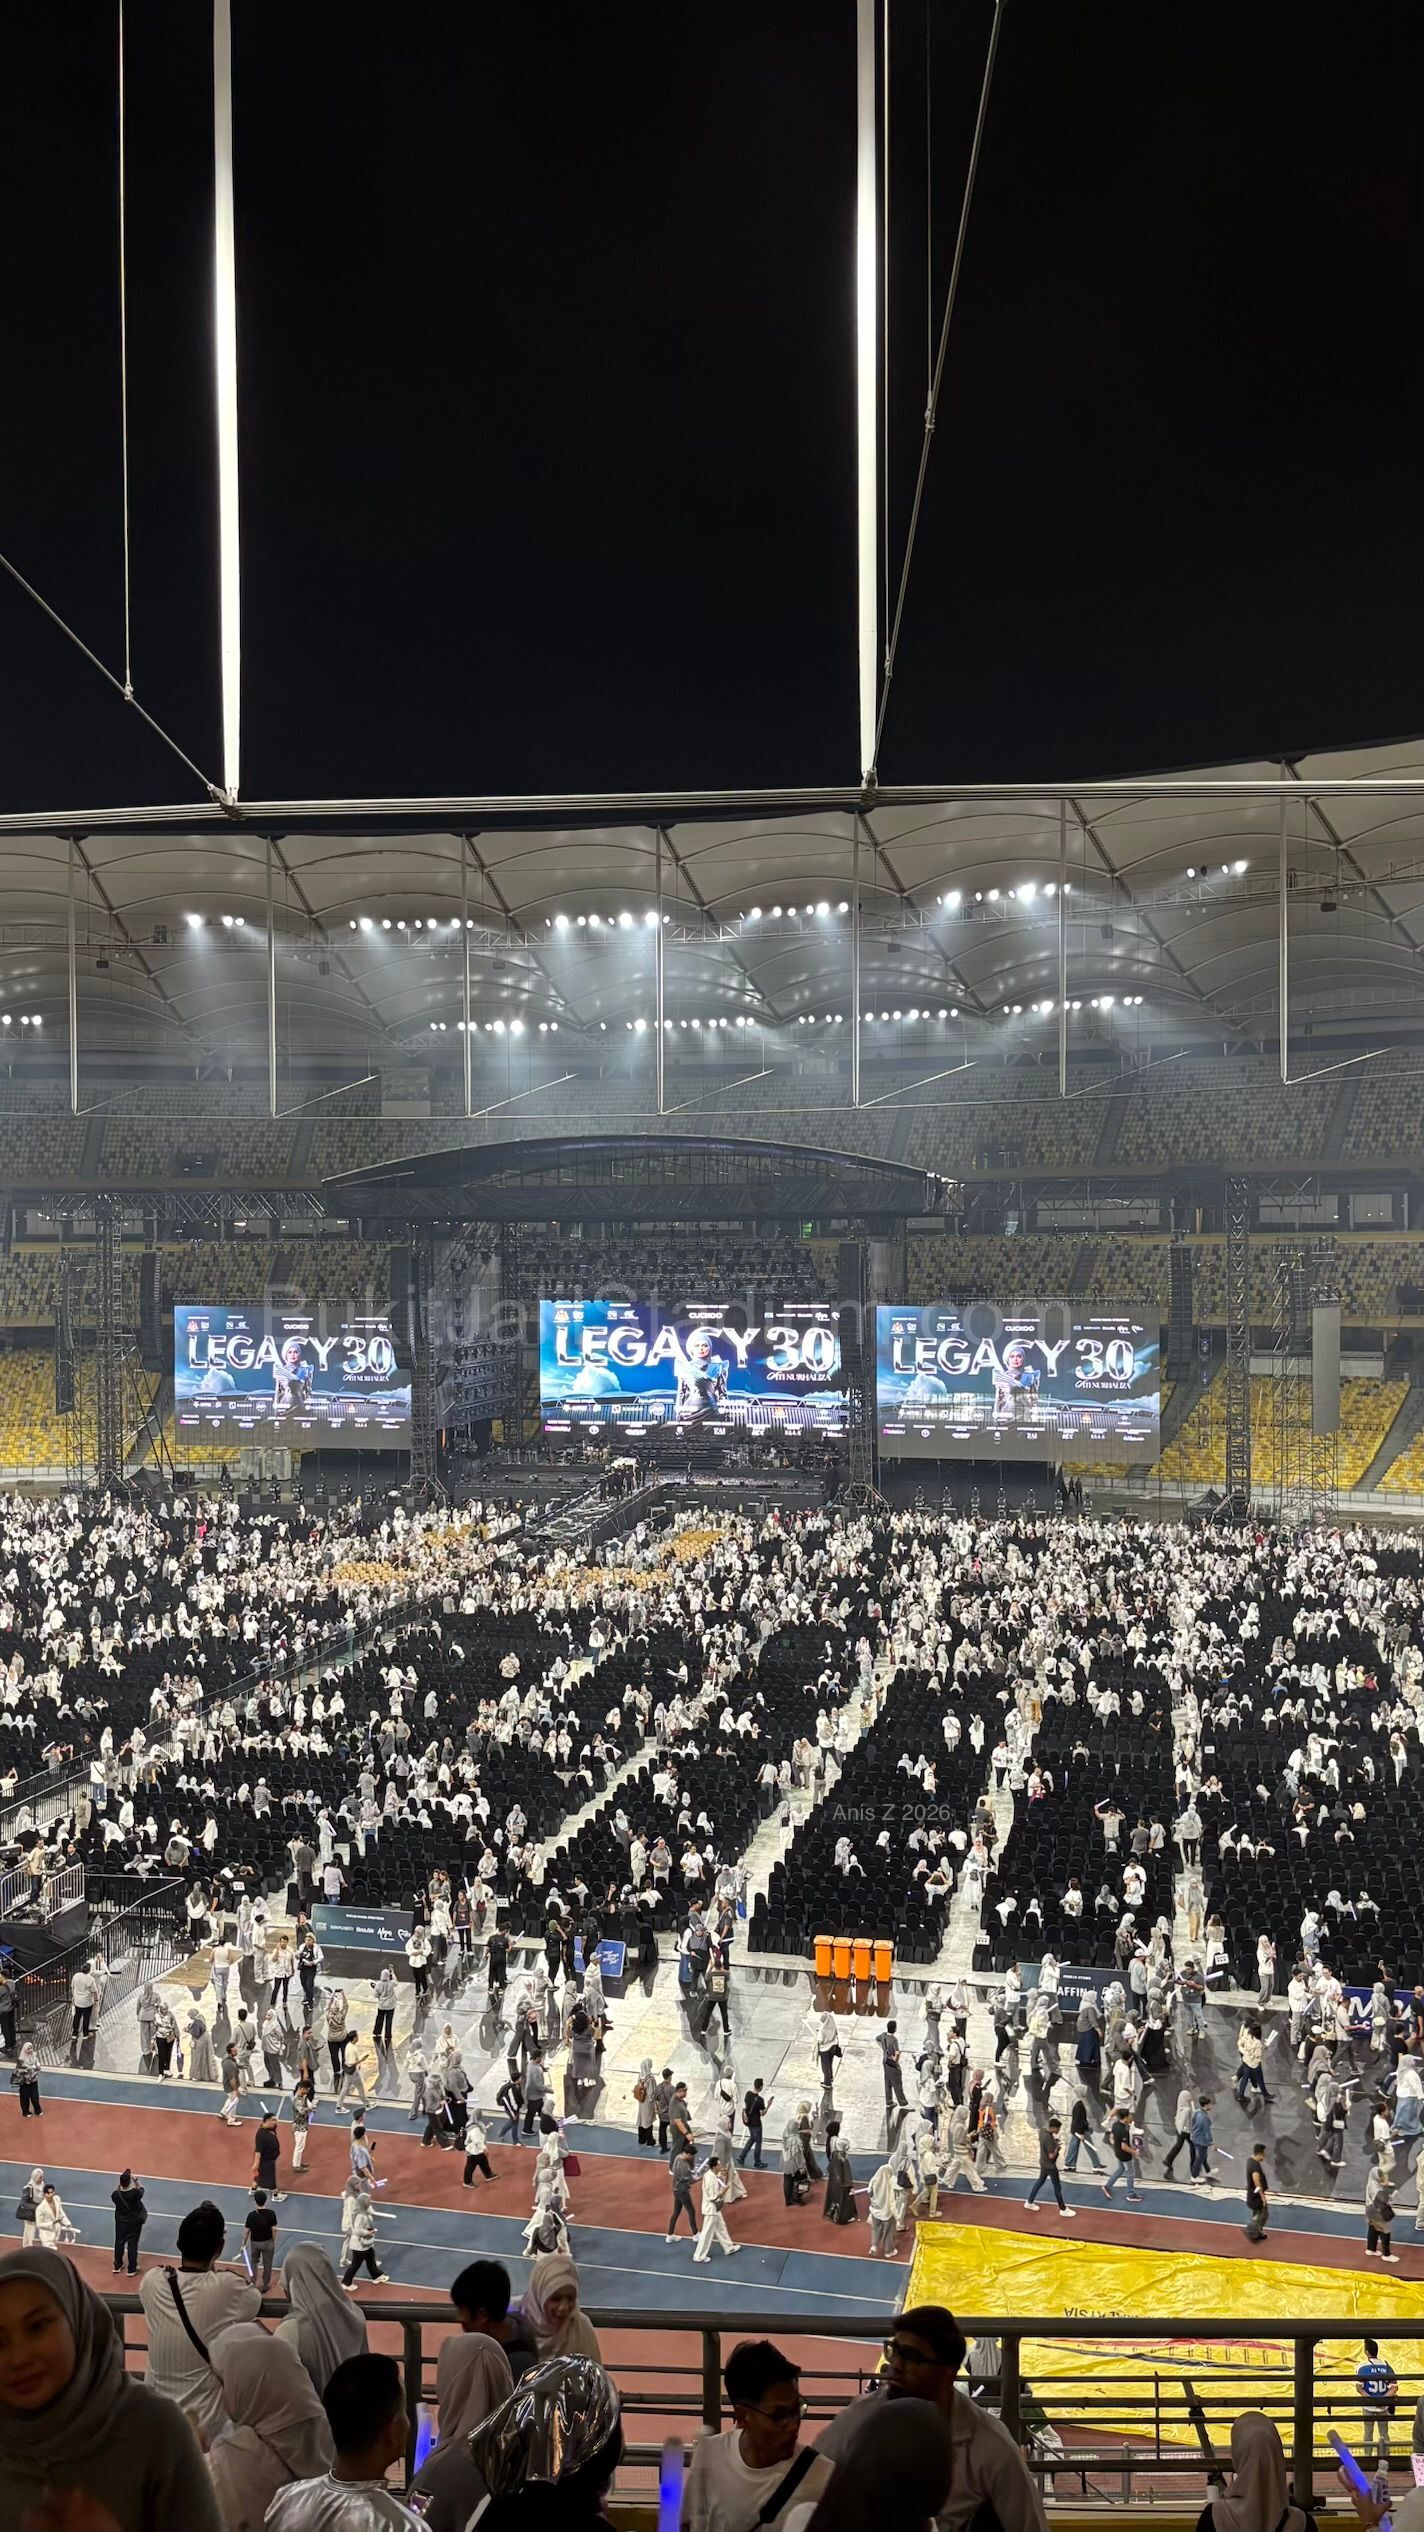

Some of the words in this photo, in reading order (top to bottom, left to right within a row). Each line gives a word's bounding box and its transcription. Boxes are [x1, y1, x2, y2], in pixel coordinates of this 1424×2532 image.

[188, 1335, 339, 1371] LEGACY
[342, 1336, 391, 1374] 30
[556, 1325, 761, 1368] LEGACY
[766, 1326, 835, 1373] 30
[893, 1337, 1070, 1377] LEGACY
[1075, 1338, 1134, 1381] 30
